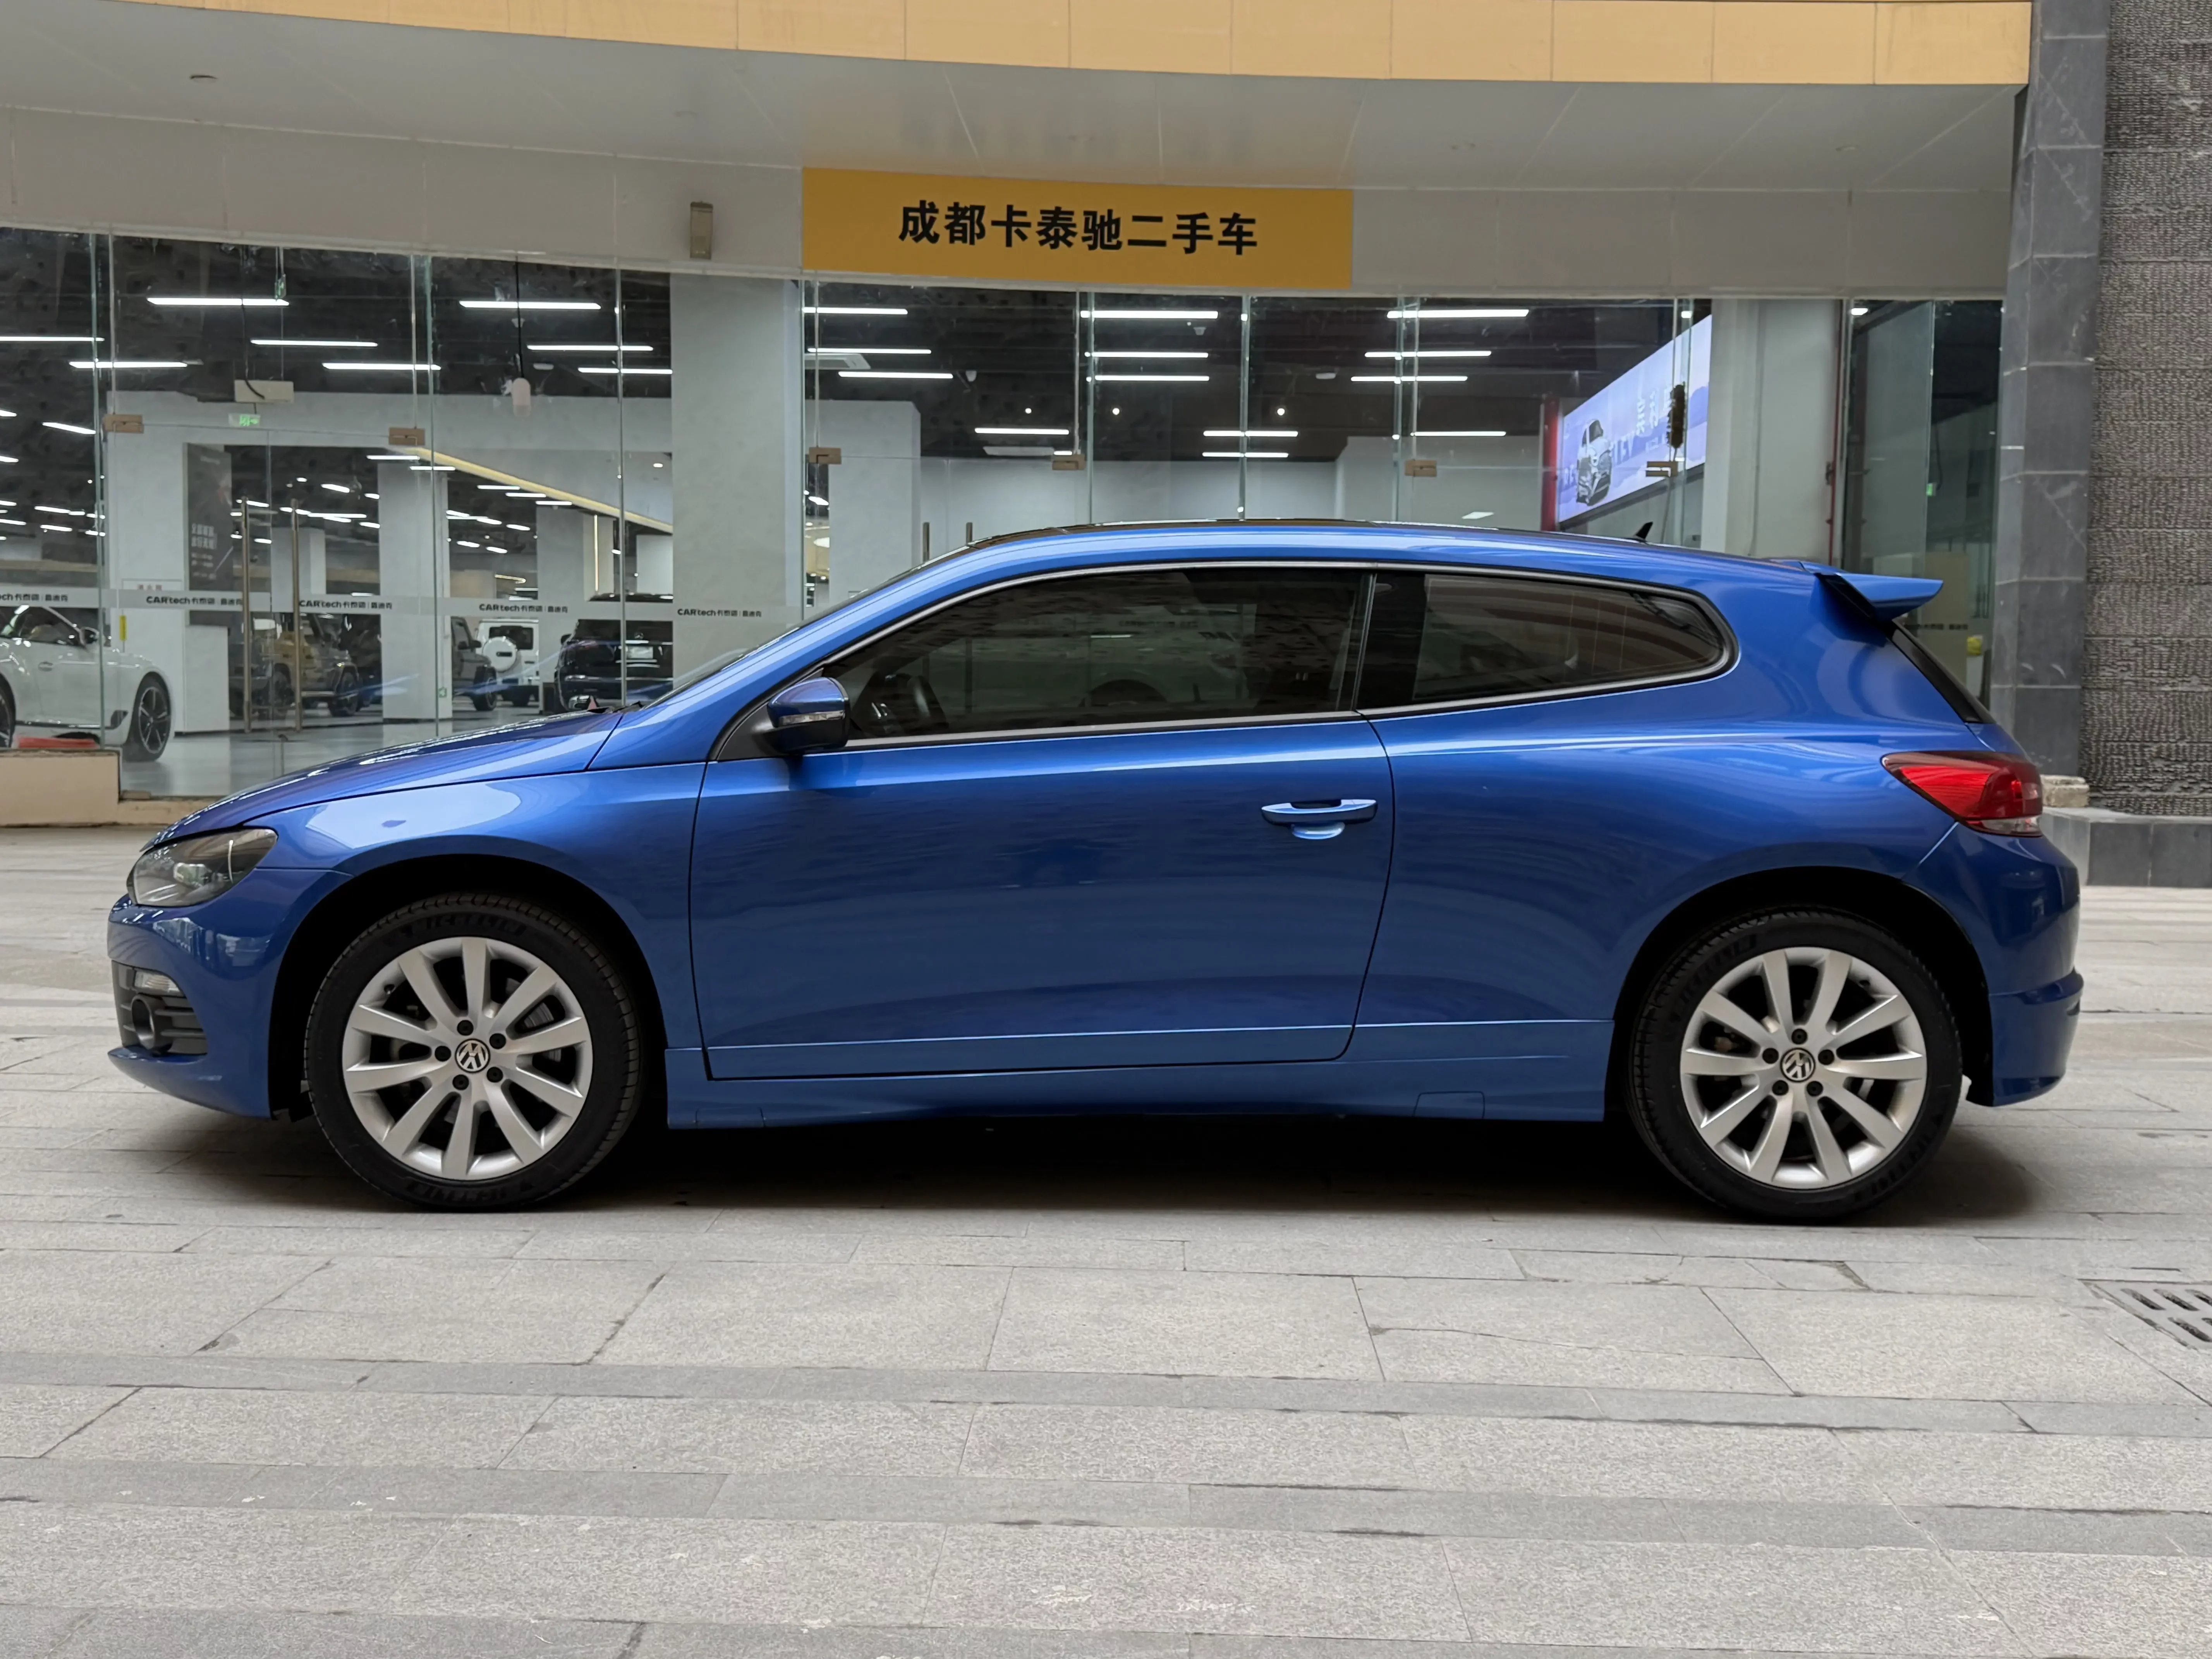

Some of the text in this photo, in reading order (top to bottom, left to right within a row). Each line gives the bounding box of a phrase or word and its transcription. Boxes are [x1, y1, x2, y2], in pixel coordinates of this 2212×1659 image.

[899, 200, 1257, 255] 成都卡泰驰二手车
